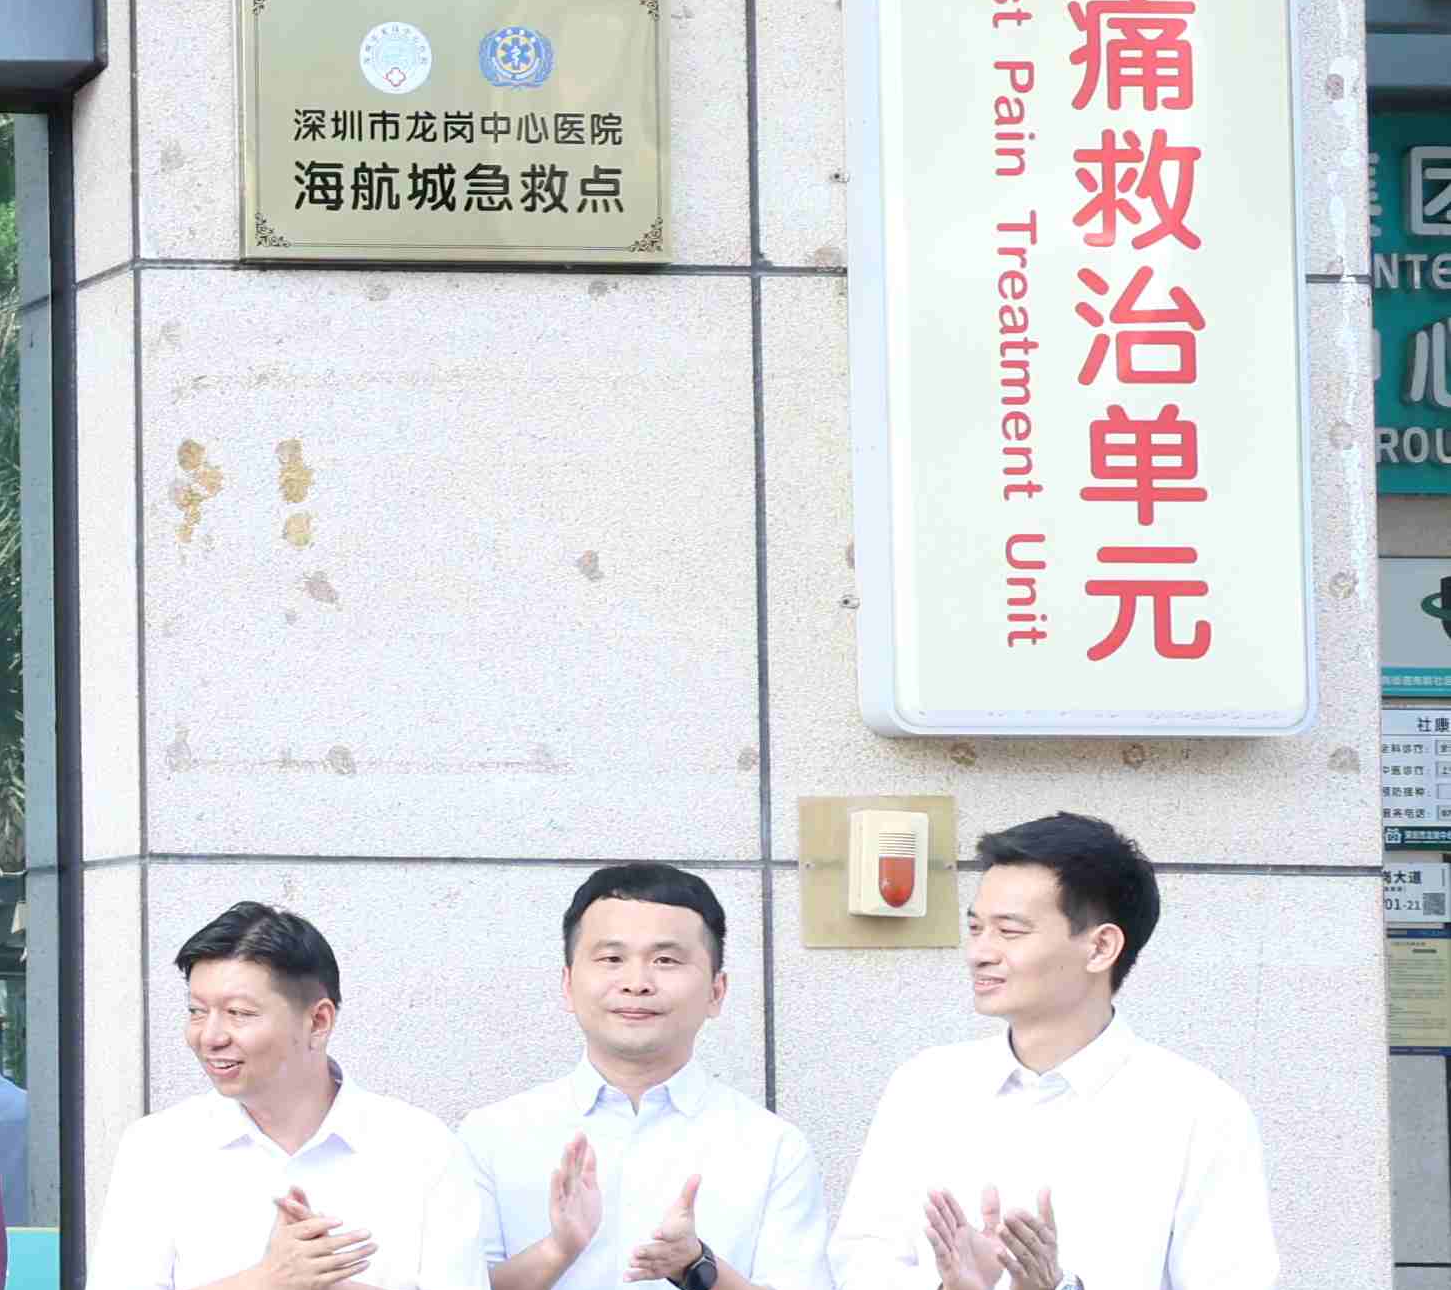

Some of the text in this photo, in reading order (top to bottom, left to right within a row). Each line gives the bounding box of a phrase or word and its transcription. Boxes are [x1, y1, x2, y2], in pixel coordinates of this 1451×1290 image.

[292, 109, 624, 146] 深圳市龙岗中心医院
[993, 61, 1036, 177] Pain
[293, 159, 625, 213] 海航城急救点
[996, 210, 1043, 501] Treatment
[1004, 532, 1048, 649] Unit
